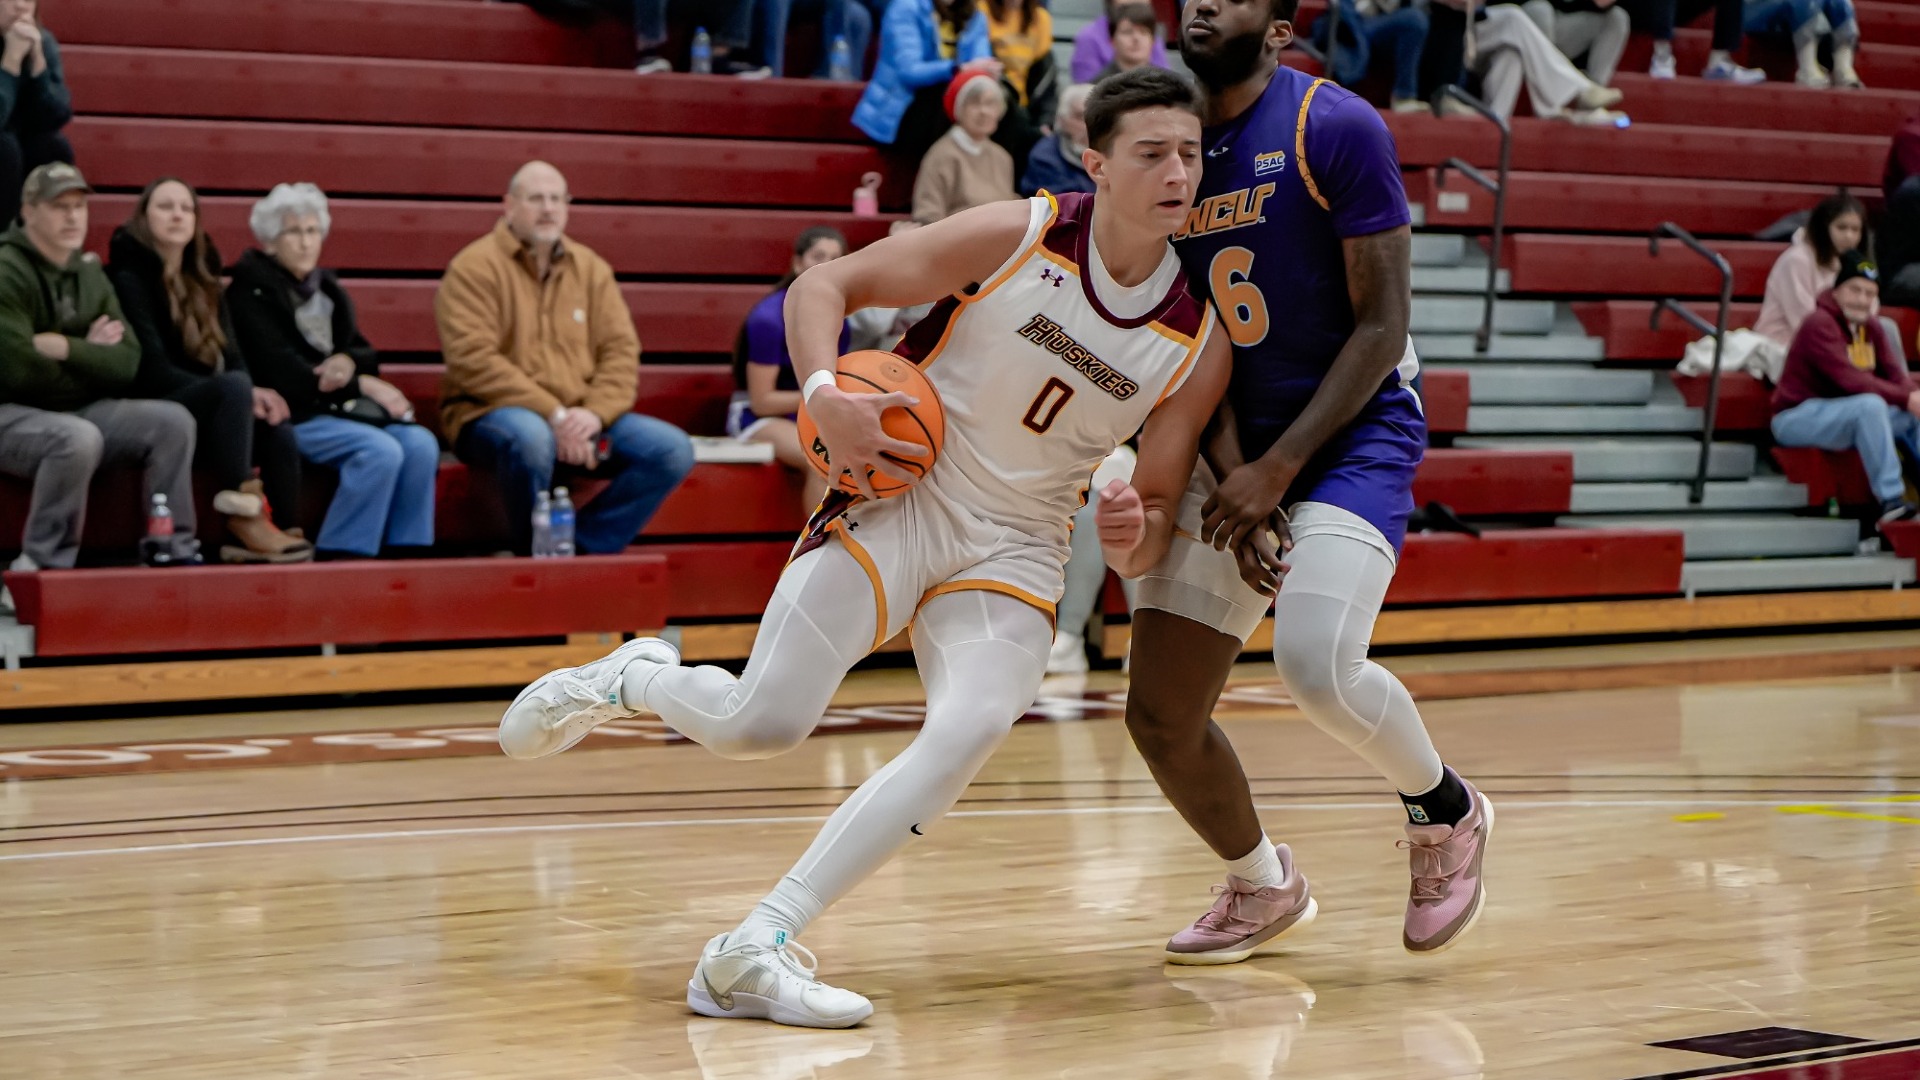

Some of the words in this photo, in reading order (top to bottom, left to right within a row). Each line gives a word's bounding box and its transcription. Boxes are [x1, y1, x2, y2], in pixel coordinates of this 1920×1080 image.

[1255, 155, 1284, 170] PSAC
[1208, 245, 1270, 347] 6
[1016, 312, 1140, 402] HUSKIES
[1021, 375, 1076, 436] 0
